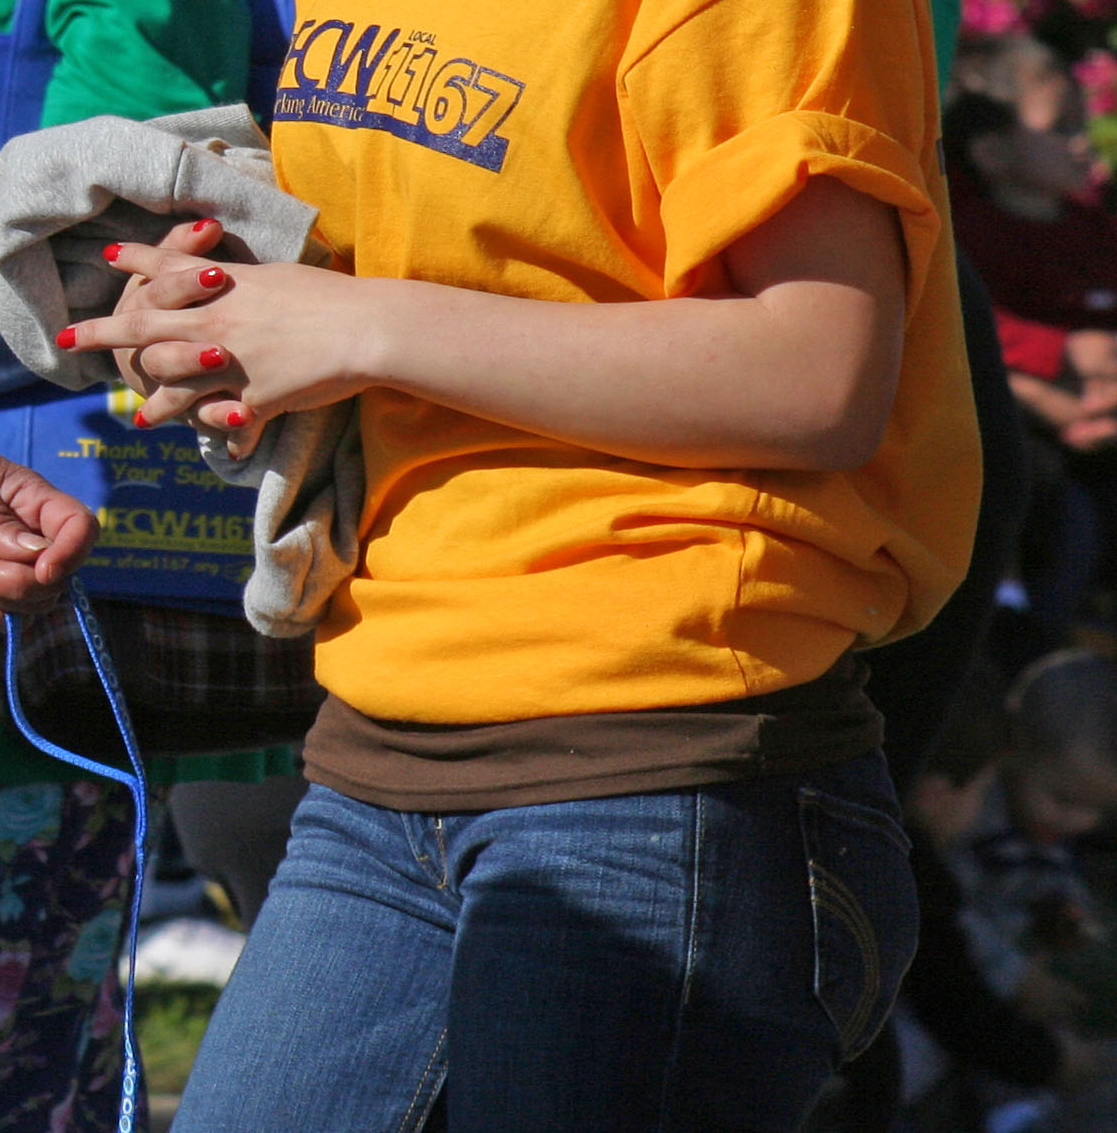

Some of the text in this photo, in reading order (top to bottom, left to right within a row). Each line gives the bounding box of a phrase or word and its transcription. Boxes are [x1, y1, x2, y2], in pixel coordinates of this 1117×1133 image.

[408, 29, 437, 46] LOCAL
[274, 93, 305, 119] rking
[112, 464, 229, 490] Your Supp
